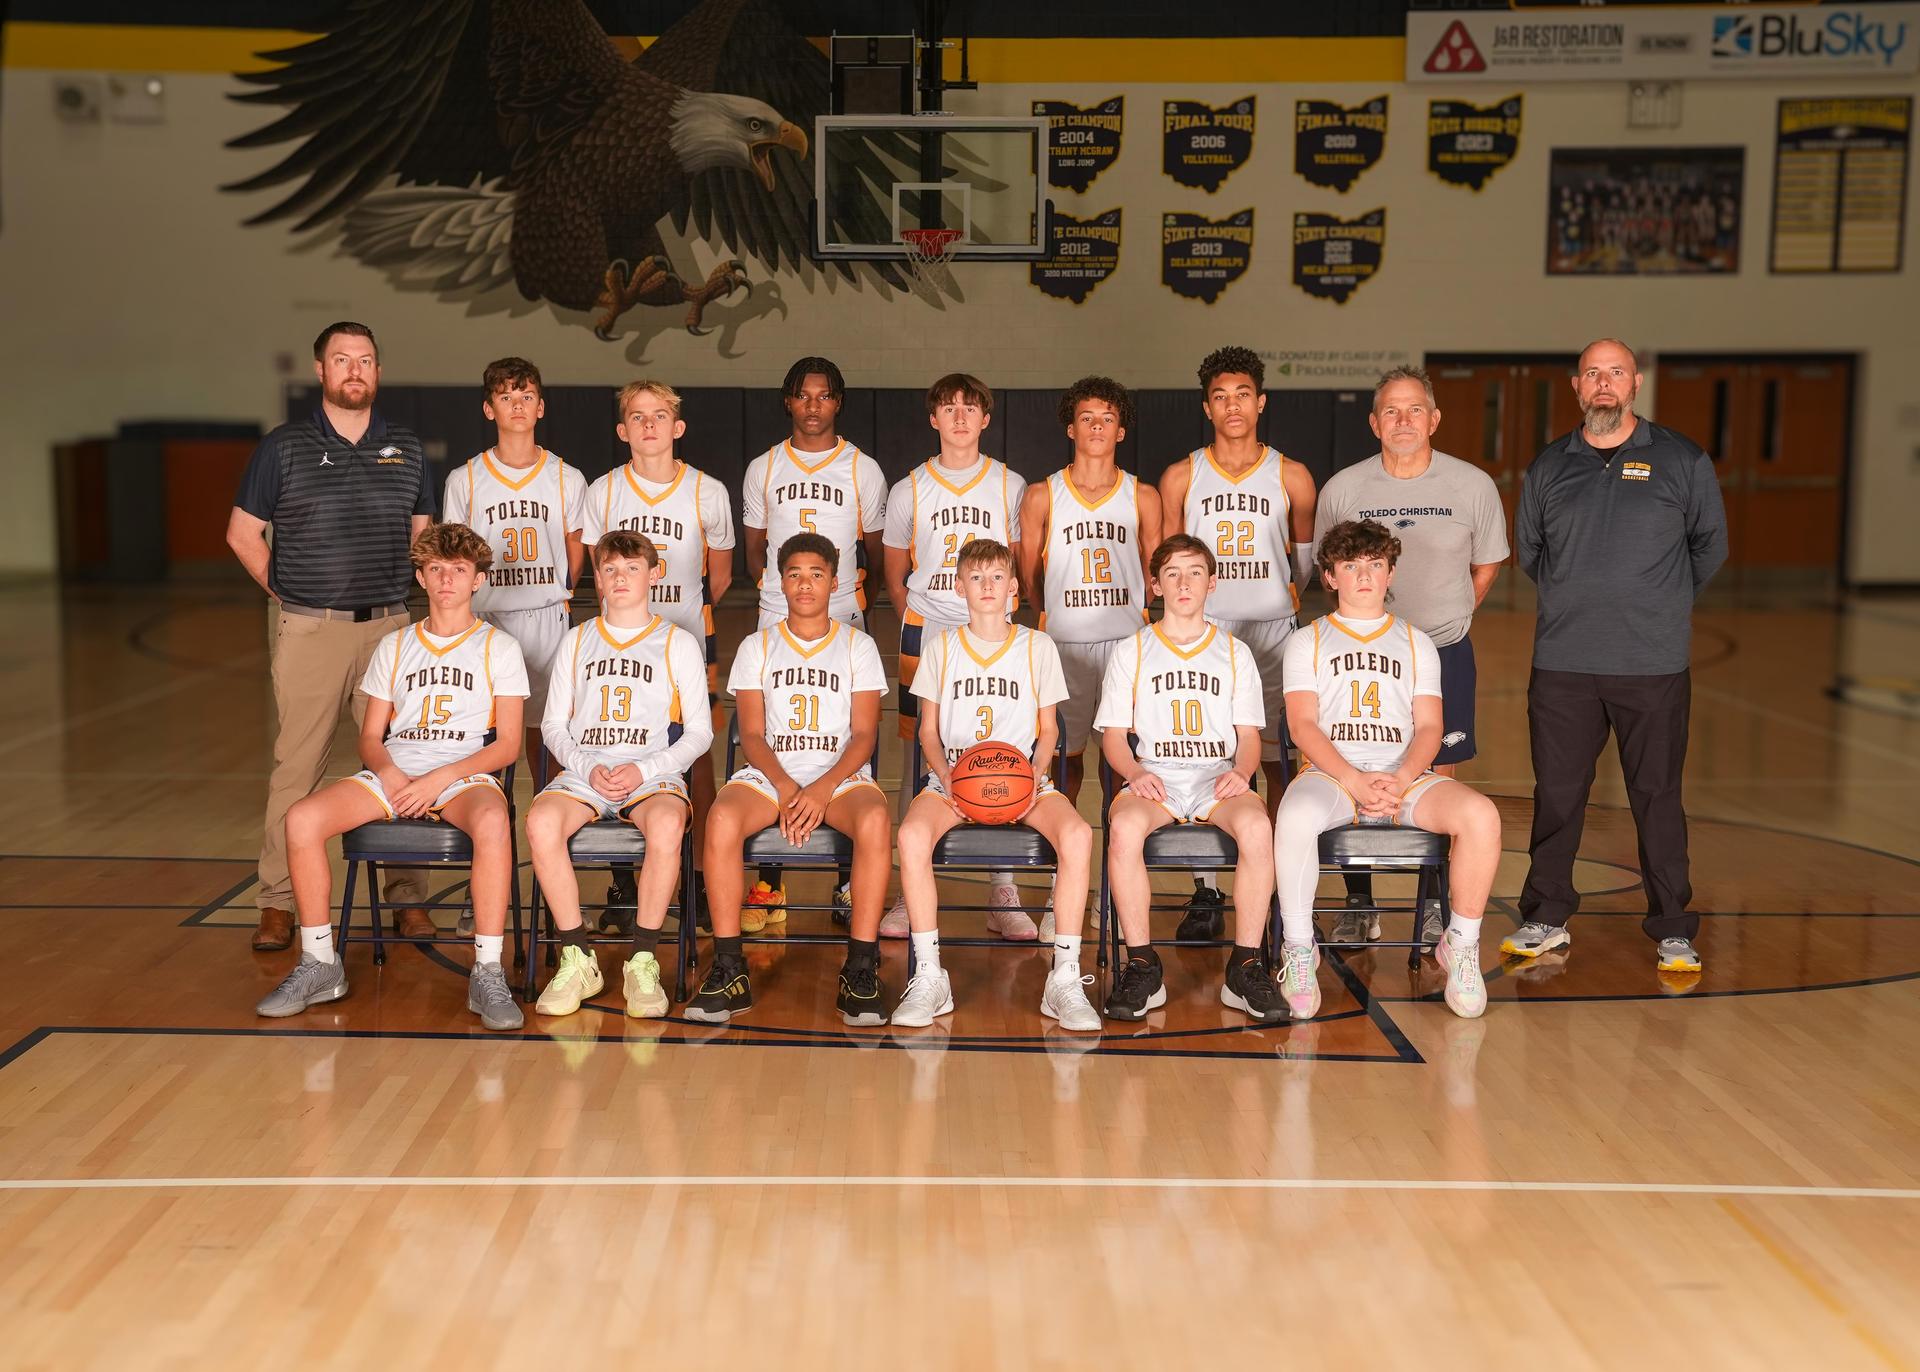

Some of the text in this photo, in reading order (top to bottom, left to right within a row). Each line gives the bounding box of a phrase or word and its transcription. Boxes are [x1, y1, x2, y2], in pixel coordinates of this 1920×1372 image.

[1522, 23, 1624, 47] RESTORATION
[1758, 12, 1906, 65] BluSky
[1067, 115, 1121, 133] CHAMPION
[1165, 114, 1253, 133] FINAL FOUR
[1298, 114, 1385, 133] FINAL FOUR
[1059, 131, 1095, 144] 2004
[1191, 135, 1226, 149] 2006
[1324, 134, 1357, 149] 2010
[1049, 146, 1114, 155] THANY MCGRAW
[1183, 154, 1234, 164] VOLLEYBALL
[1058, 159, 1096, 167] LONG JUMP
[1065, 226, 1120, 244] CHAMPION
[1164, 226, 1252, 245] STATE CHAMPION
[1294, 226, 1383, 245] STATE CHAMPION
[1060, 242, 1091, 255] 2012
[1191, 242, 1223, 256] 2013
[1061, 269, 1084, 278] METER
[1084, 269, 1107, 278] RELAY
[776, 482, 844, 506] TOLEDO
[485, 500, 550, 525] TOLEDO
[1201, 493, 1270, 517] TOLEDO
[1359, 507, 1452, 519] TOLEDO CHRISTIAN
[619, 516, 683, 541] TOLEDO
[800, 508, 817, 535] 5
[930, 506, 991, 530] TOLEDO
[1063, 521, 1127, 545] TOLEDO
[1216, 520, 1255, 556] 22
[501, 527, 539, 563] 30
[1081, 548, 1112, 583] 12
[1217, 561, 1270, 580] RISTIAN
[488, 566, 555, 587] CHRISTIAN
[1064, 587, 1130, 608] CHRISTIAN
[585, 657, 654, 684] TOLEDO
[1330, 651, 1402, 680] TOLEDO
[405, 666, 474, 692] TOLEDO
[772, 666, 840, 693] TOLEDO
[953, 677, 1019, 701] TOLEDO
[1151, 670, 1220, 696] TOLEDO
[600, 684, 633, 722] 13
[1350, 680, 1381, 719] 14
[416, 694, 453, 729] 15
[788, 693, 820, 732] 31
[1170, 699, 1203, 736] 10
[975, 705, 994, 741] 3
[1330, 723, 1402, 743] CHRISTIAN
[396, 728, 466, 741] HRISTIAN
[580, 727, 649, 746] CHRISTIAN
[1154, 740, 1226, 758] CHRISTIAN
[969, 752, 1021, 771] Rawlings
[983, 787, 1008, 796] OHSAA
